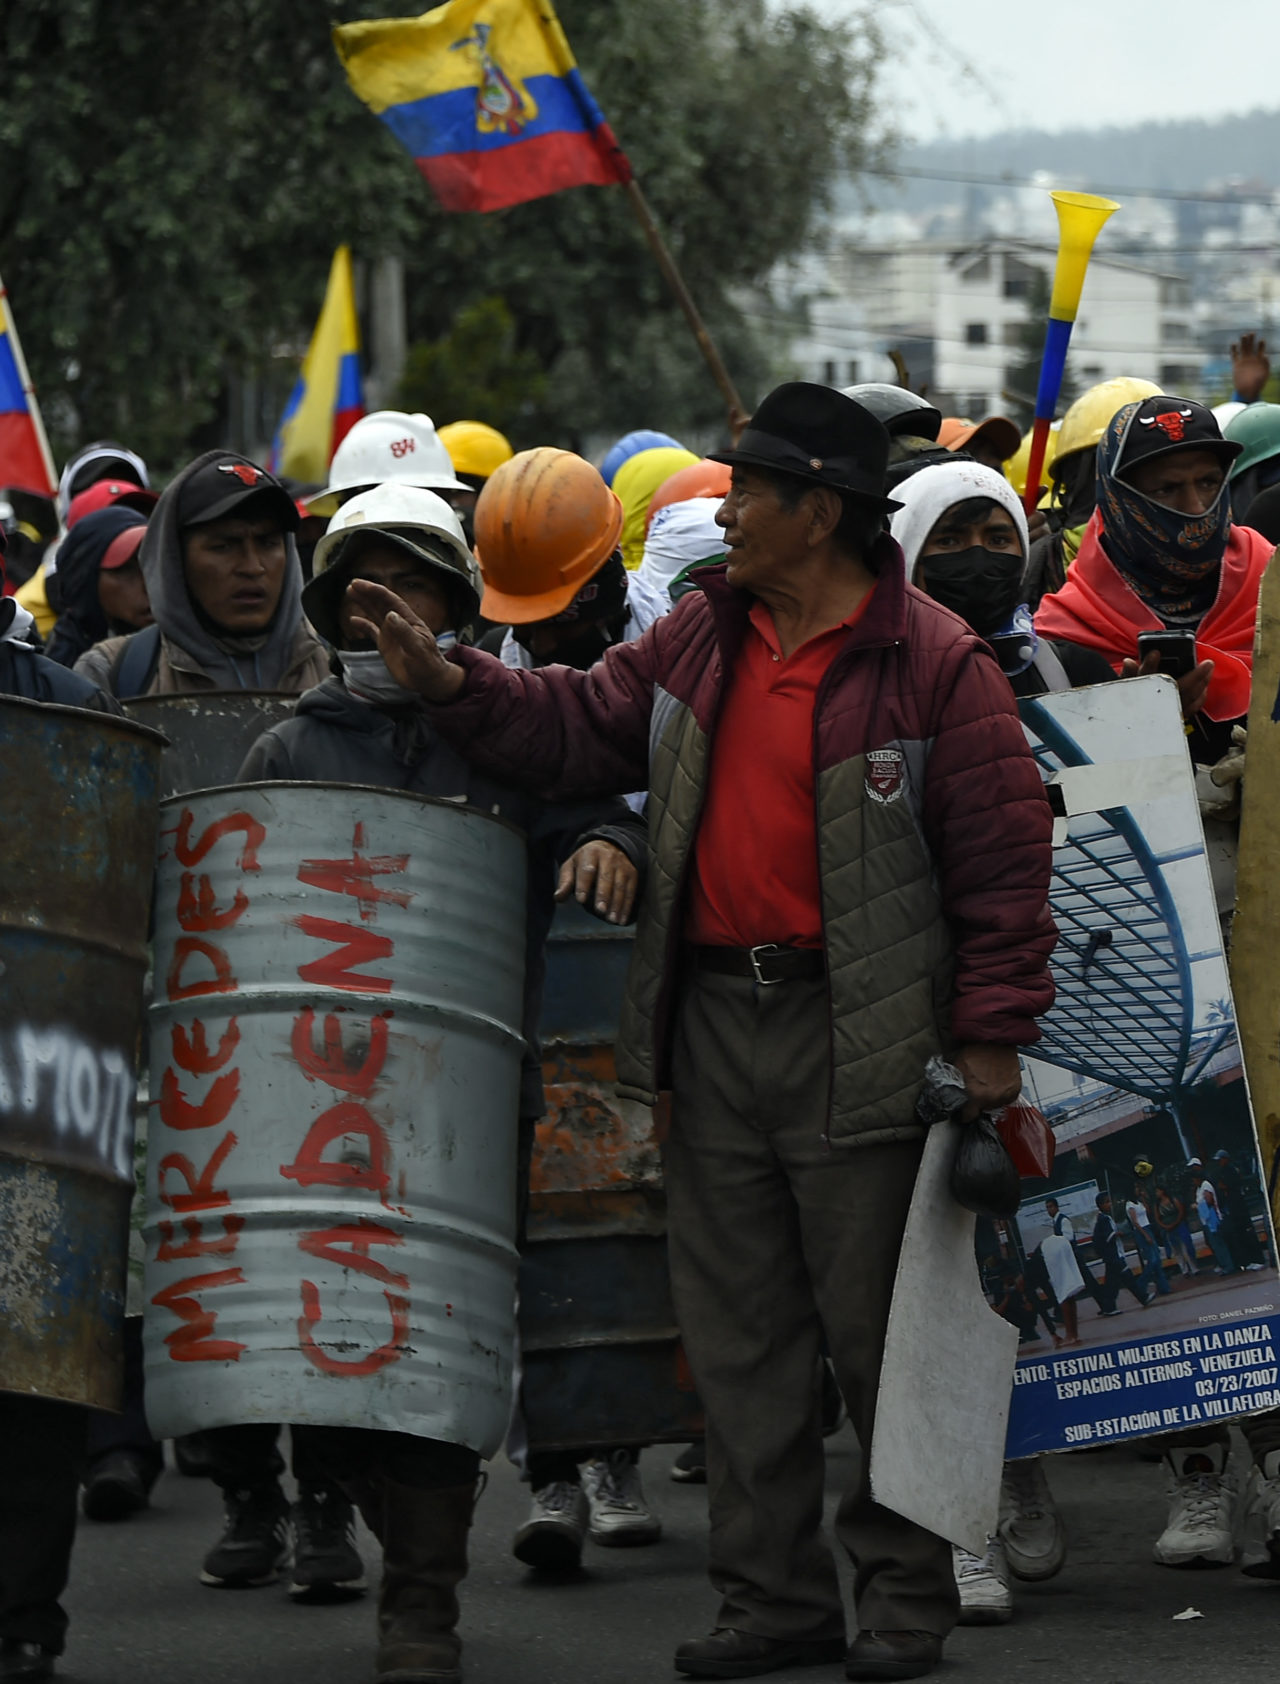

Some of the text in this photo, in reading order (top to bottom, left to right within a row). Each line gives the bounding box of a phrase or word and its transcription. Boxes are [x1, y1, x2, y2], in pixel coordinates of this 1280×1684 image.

[874, 752, 897, 761] HRC
[152, 805, 266, 1362] MERCEDES
[1219, 1309, 1245, 1320] DANIEL
[1052, 1352, 1117, 1379] FESTIVAL
[1117, 1340, 1182, 1367] MUJERES
[1182, 1336, 1202, 1355] EN
[1203, 1332, 1223, 1351] LA
[1223, 1324, 1273, 1347] DANZA
[1056, 1346, 1276, 1400] ESPACIOS ALTERNOS- VENEZUELA
[1195, 1367, 1279, 1397] 03/23/2007
[1064, 1410, 1161, 1443] SUB-ESTACIÓN
[1162, 1407, 1181, 1426] DE
[1182, 1404, 1202, 1422] LA
